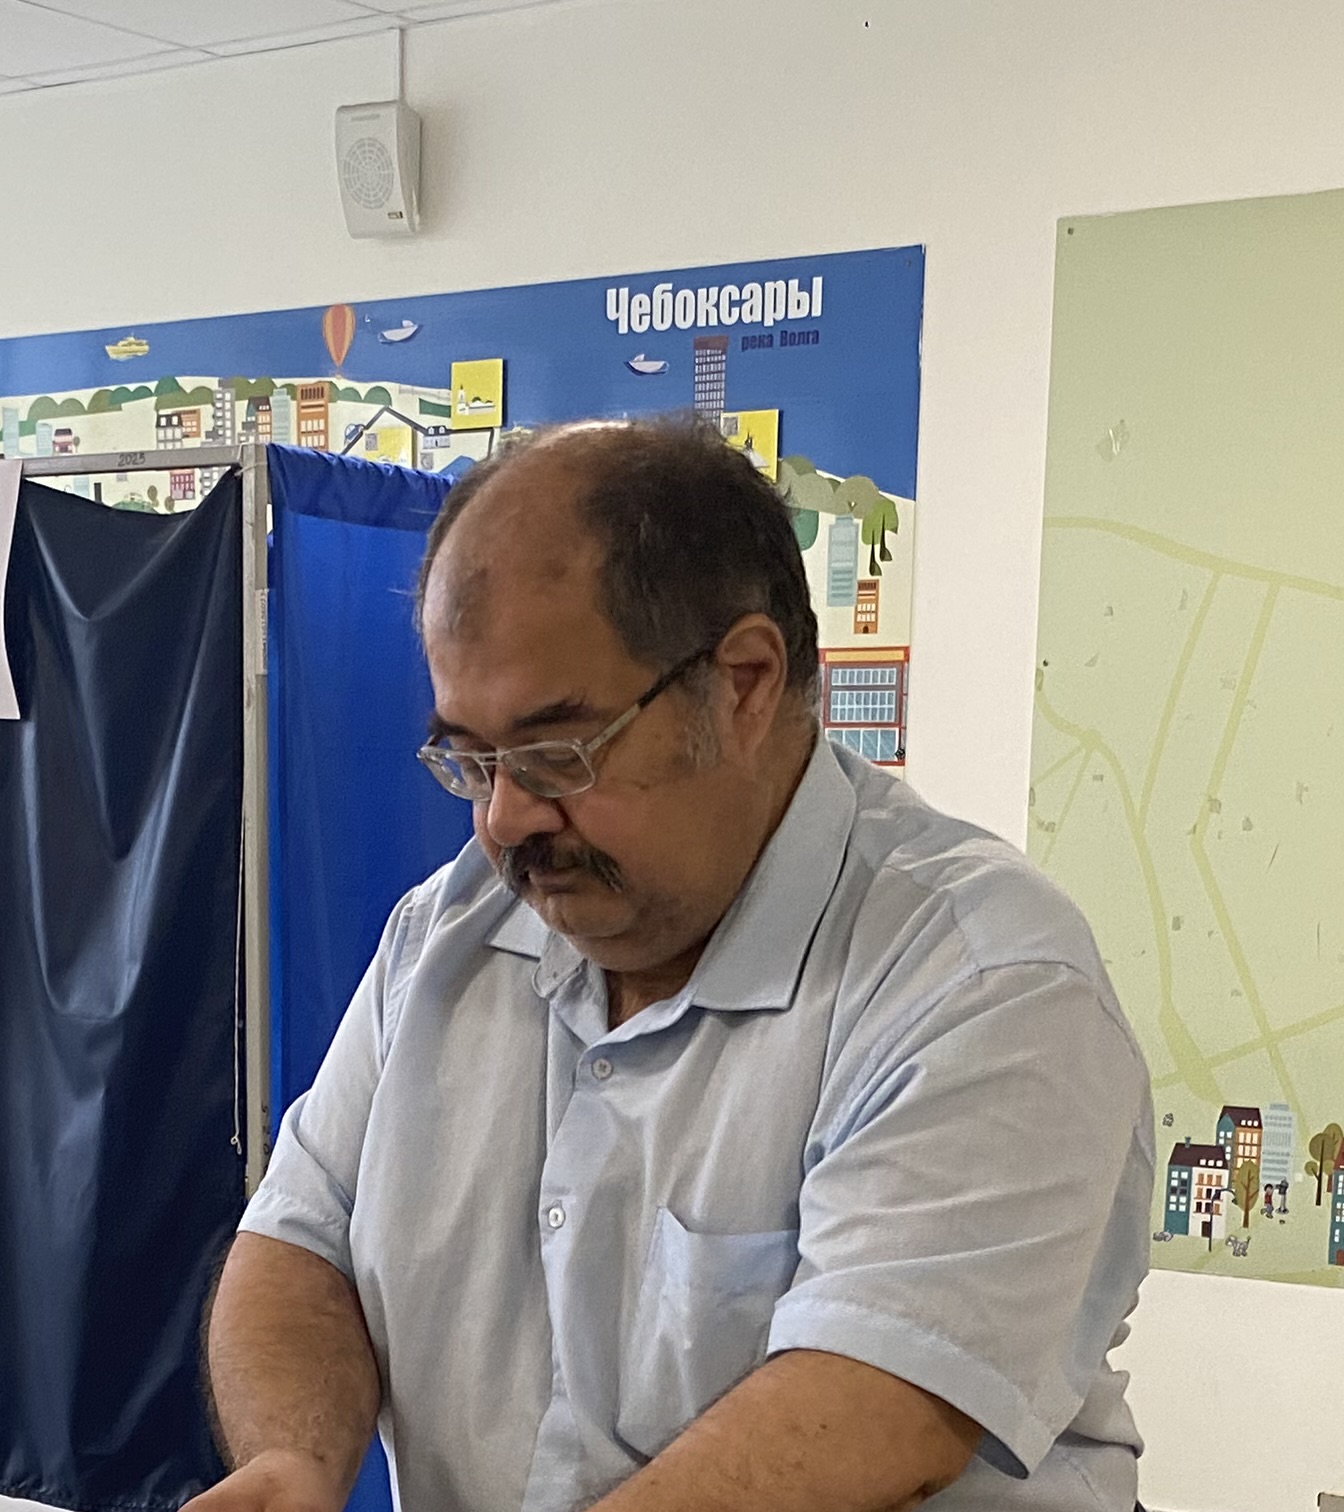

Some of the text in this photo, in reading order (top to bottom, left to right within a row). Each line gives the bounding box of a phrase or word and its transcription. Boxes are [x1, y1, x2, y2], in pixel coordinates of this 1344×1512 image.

[606, 277, 823, 334] Чебоксары
[741, 328, 820, 352] река Волга
